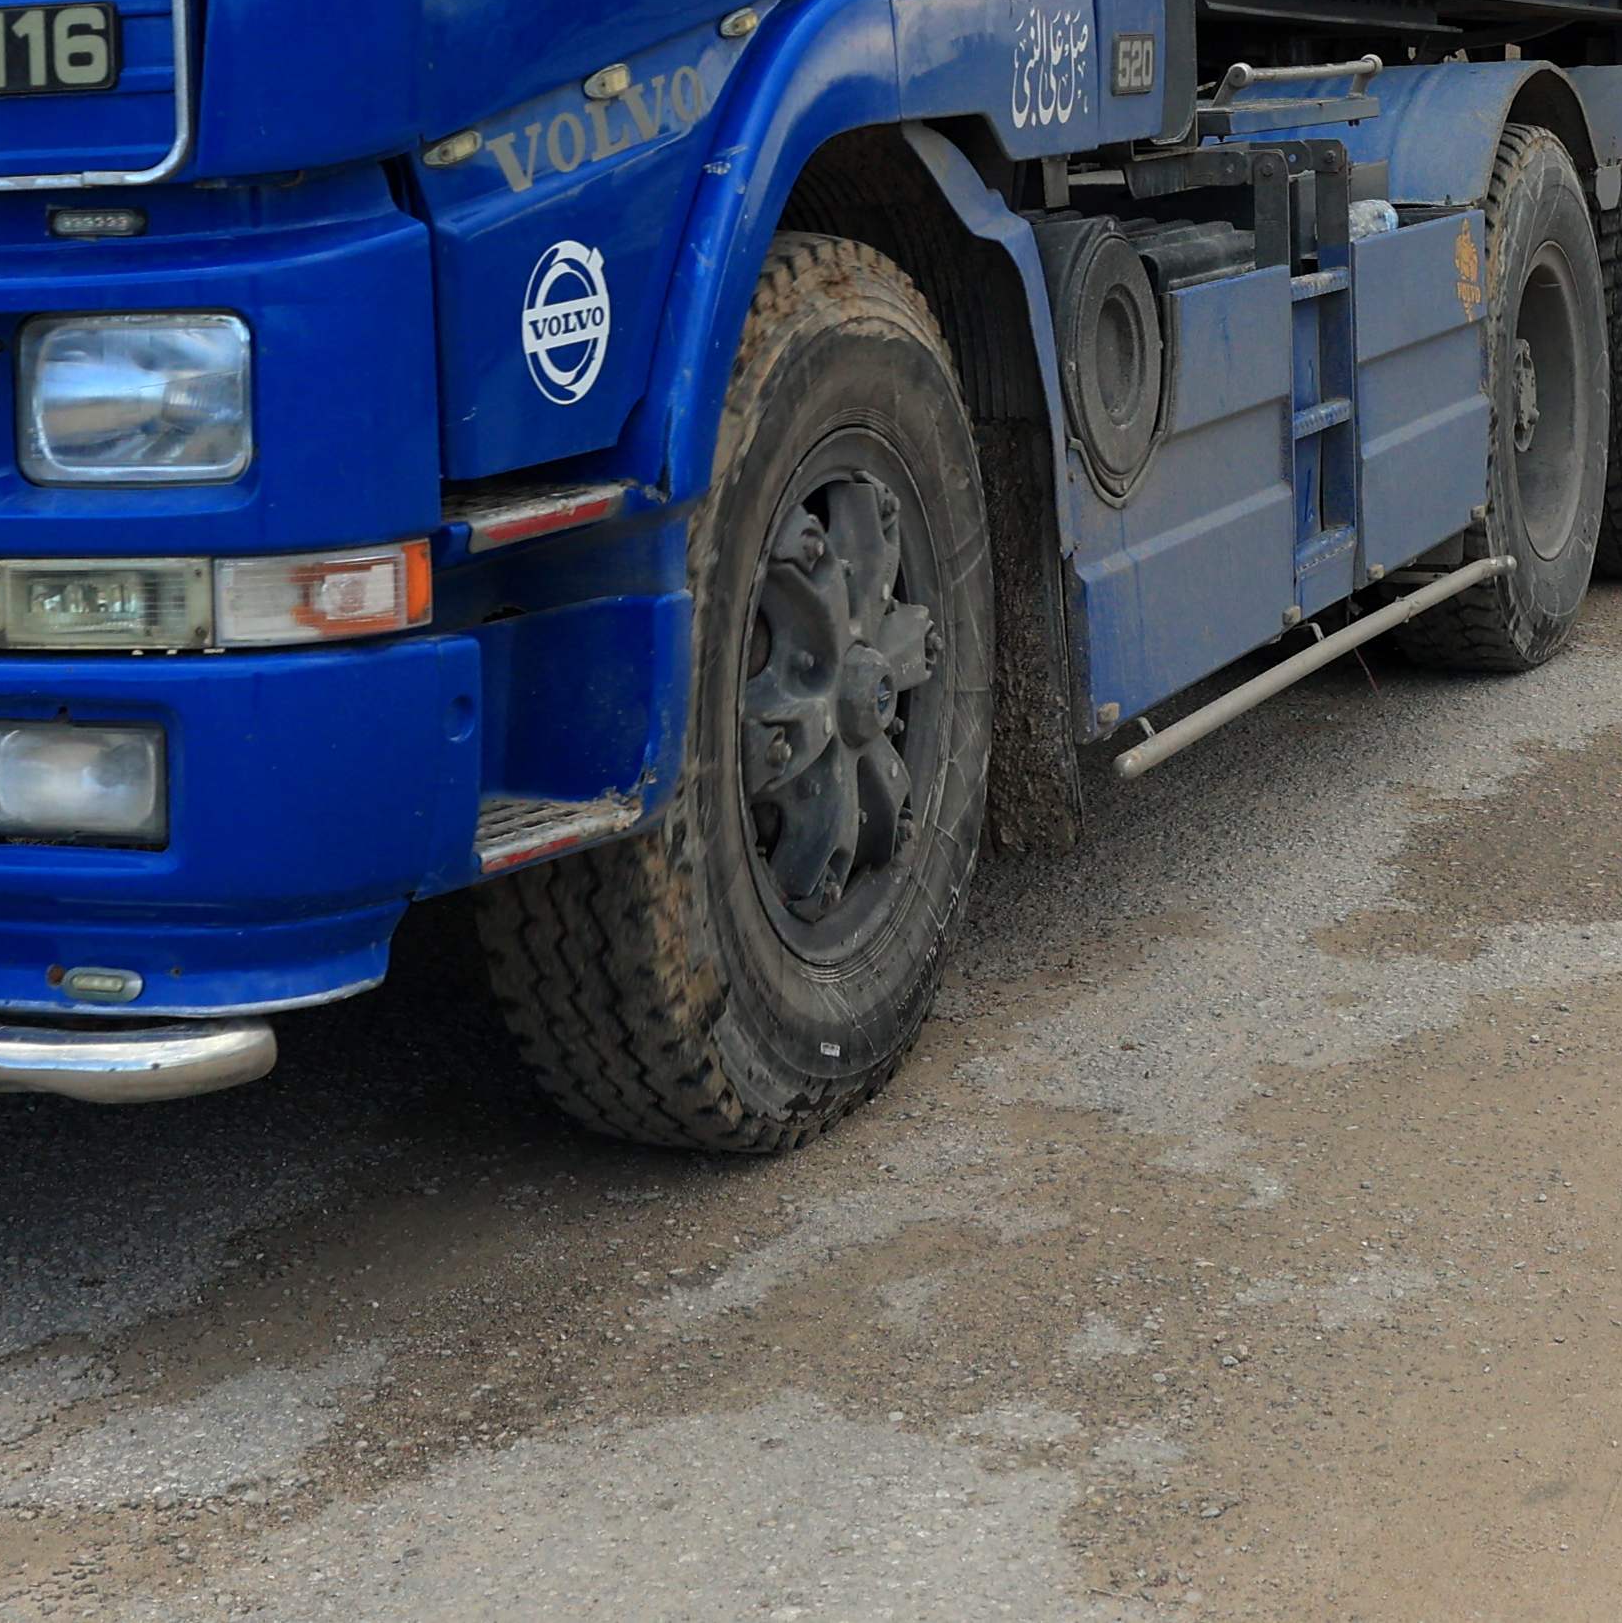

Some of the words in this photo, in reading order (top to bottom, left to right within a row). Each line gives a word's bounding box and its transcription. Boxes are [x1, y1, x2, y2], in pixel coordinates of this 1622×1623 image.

[1117, 39, 1154, 88] 520
[485, 65, 703, 194] VOLVO
[529, 306, 605, 342] VOLVO
